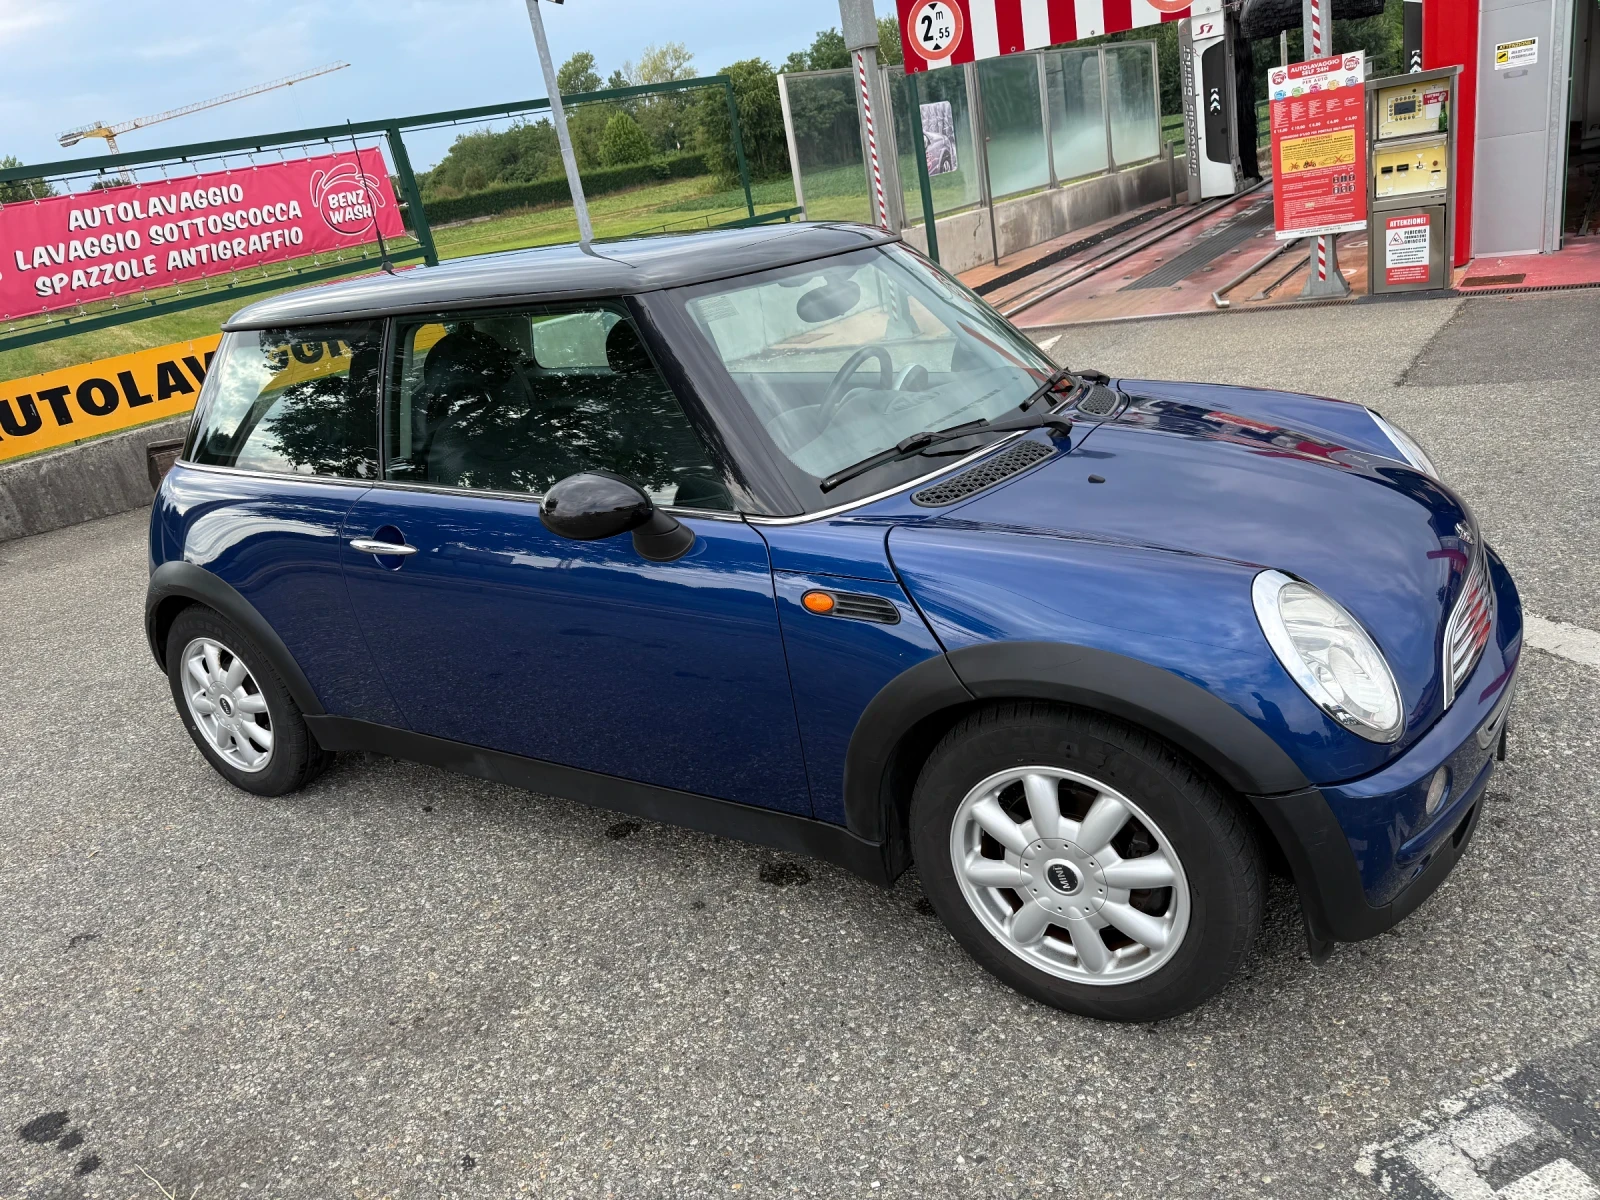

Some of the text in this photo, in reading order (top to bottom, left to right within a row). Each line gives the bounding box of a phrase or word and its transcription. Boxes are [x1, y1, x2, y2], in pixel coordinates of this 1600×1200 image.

[1182, 45, 1193, 96] Barrier
[1290, 58, 1340, 73] AUTOLAVAGGIO
[68, 183, 244, 232] AUTOLAVAGGIO
[327, 188, 366, 210] BENZ
[328, 202, 373, 225] WASH
[1390, 217, 1426, 228] ATTENZIONE!
[15, 200, 302, 272] LAVAGGIO SOTTOSCOCCA
[35, 226, 303, 297] SPAZZOLE ANTIGRAFFIO
[1054, 866, 1071, 889] MINI
